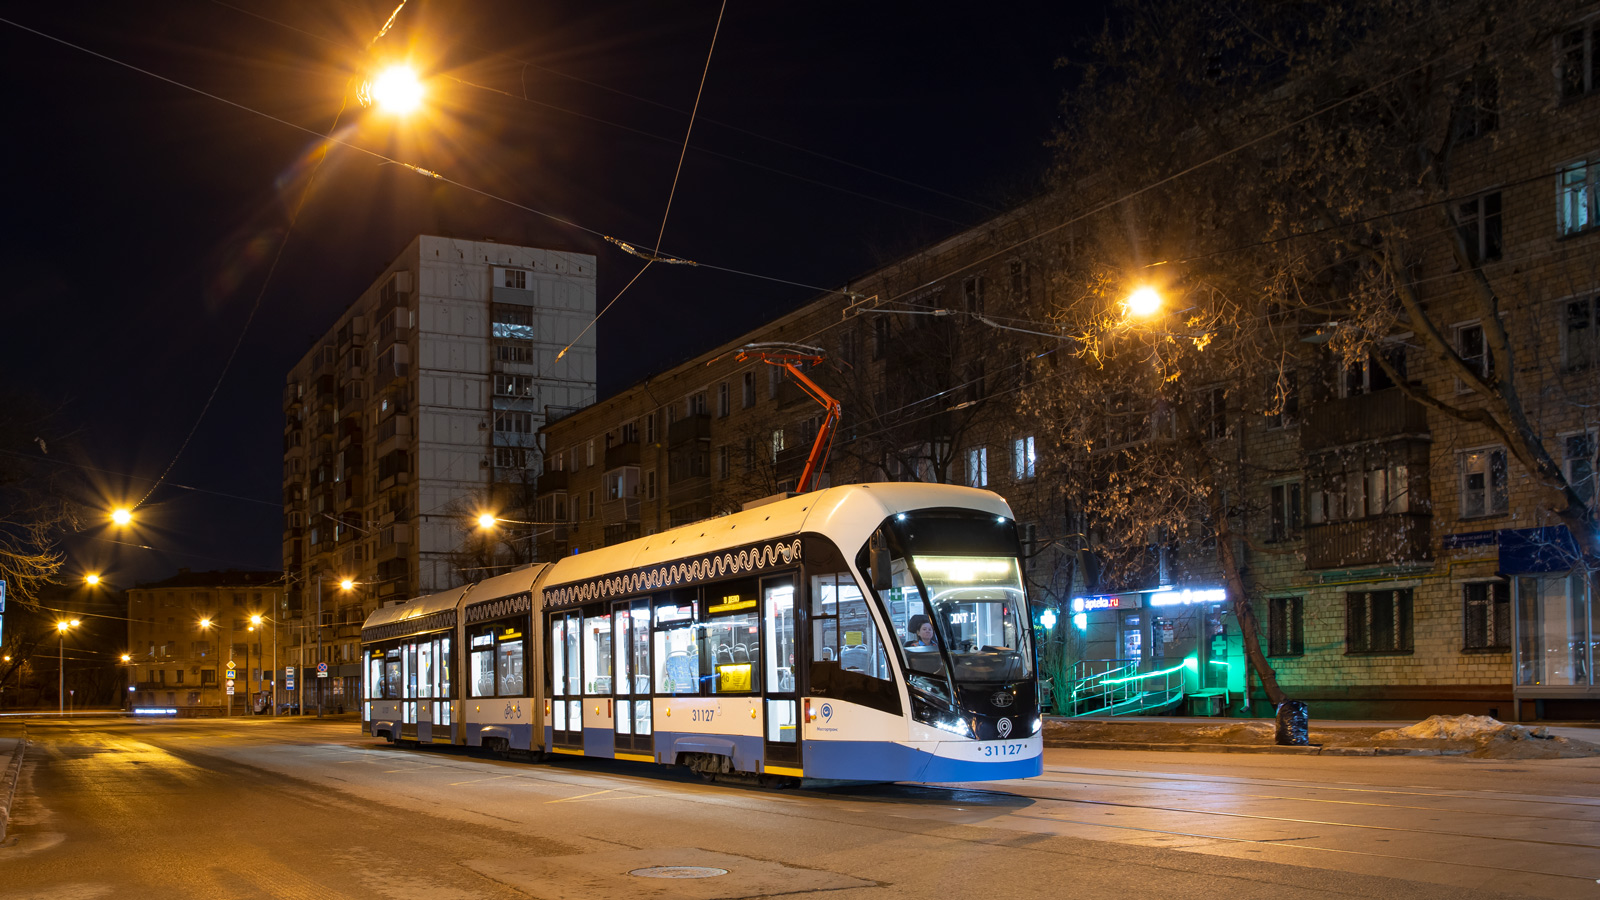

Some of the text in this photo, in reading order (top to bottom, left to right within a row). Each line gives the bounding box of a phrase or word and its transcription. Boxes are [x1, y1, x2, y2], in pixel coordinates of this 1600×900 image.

[1085, 597, 1119, 611] apteka.ru
[692, 709, 715, 722] 31127
[984, 744, 1022, 757] 31127
